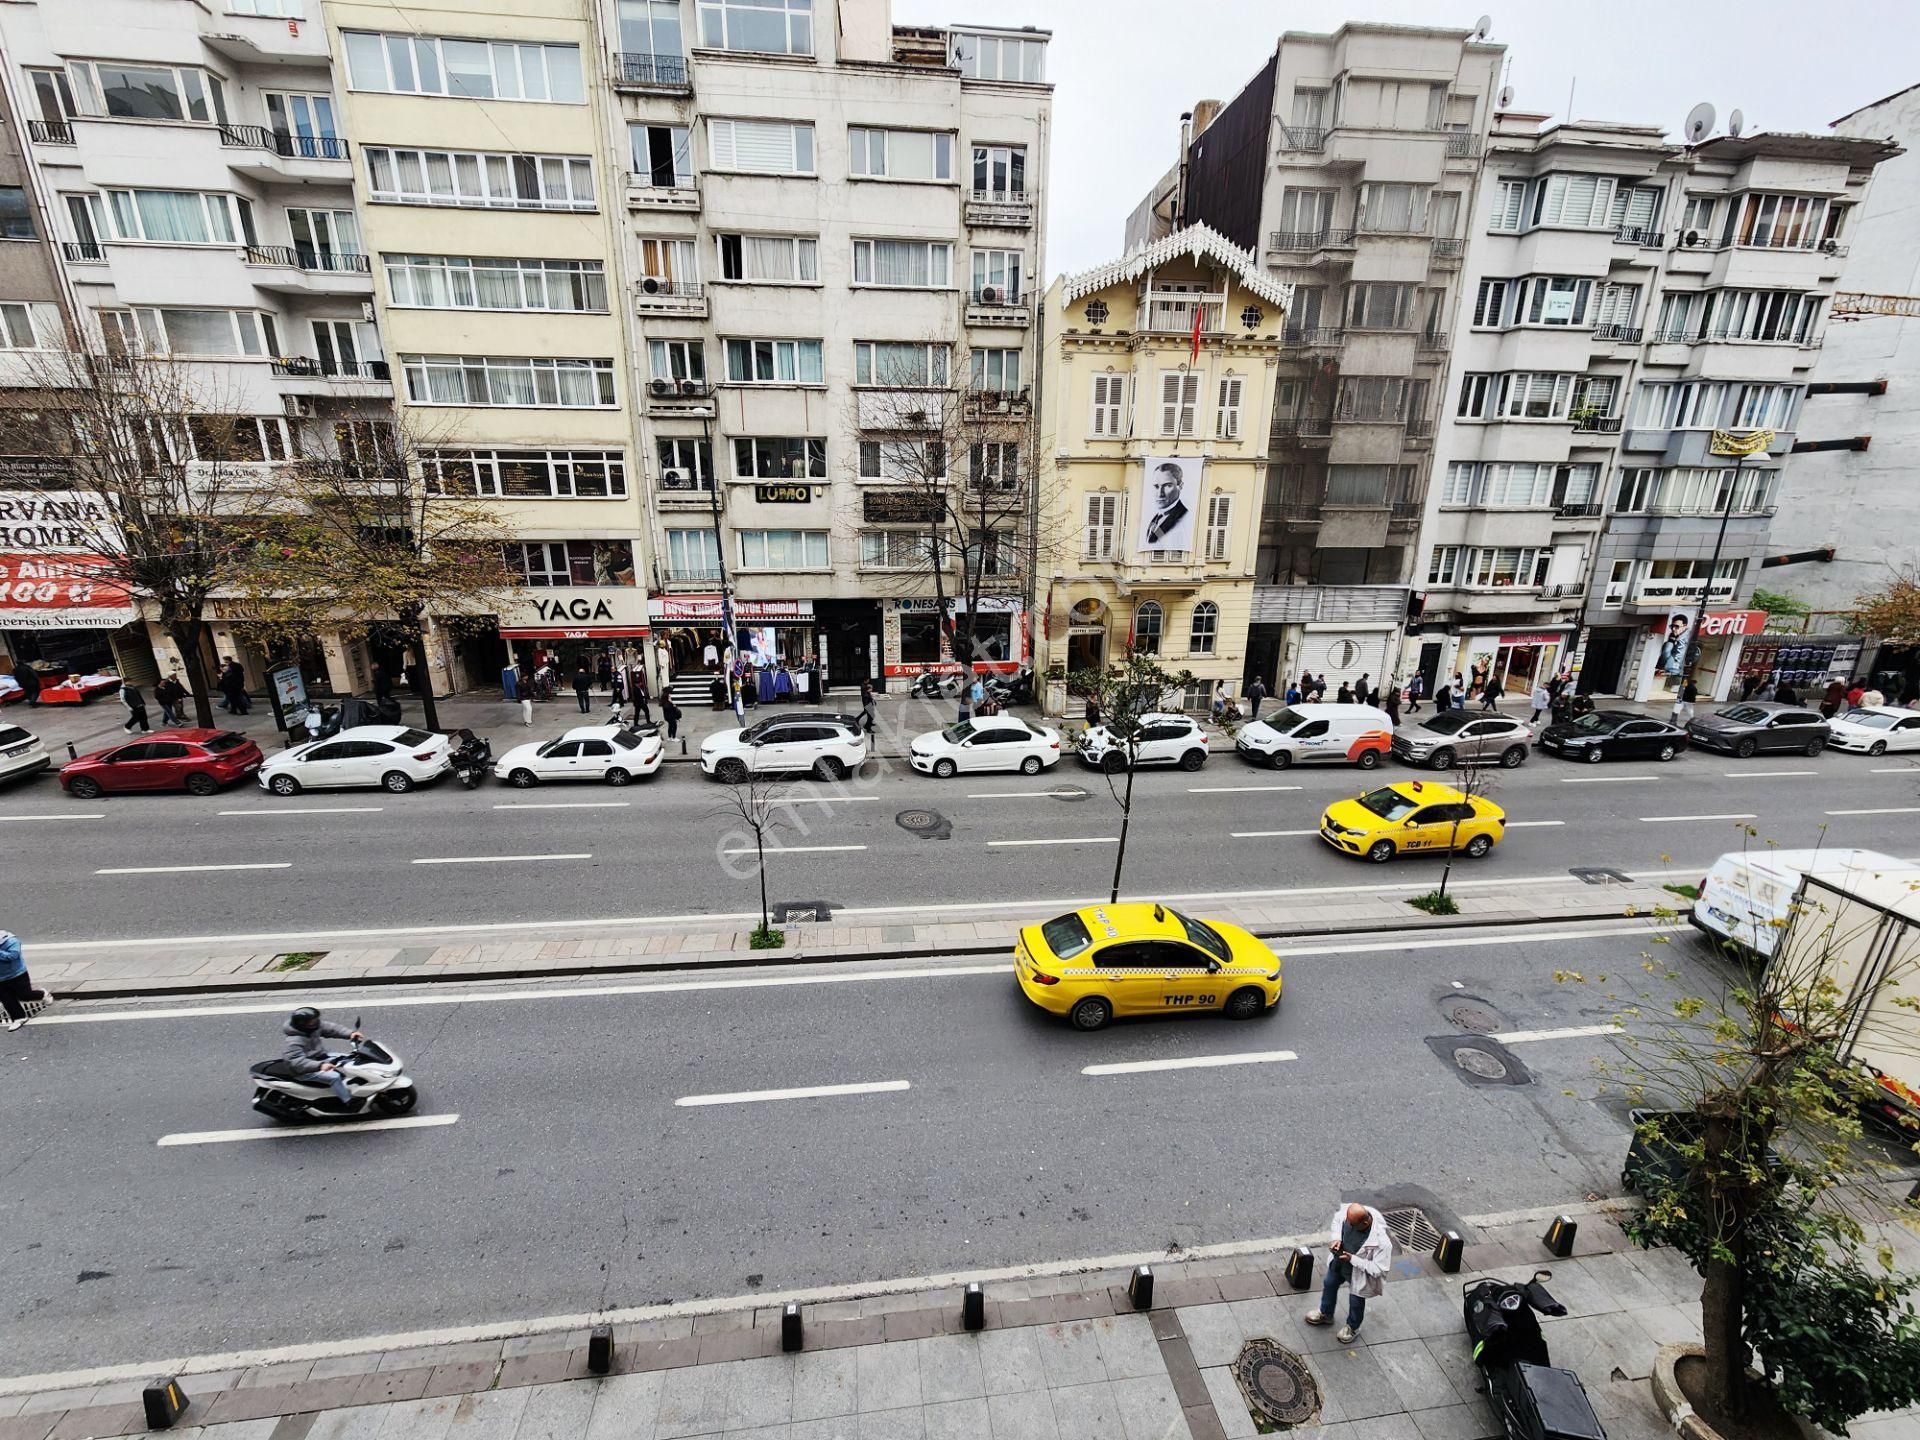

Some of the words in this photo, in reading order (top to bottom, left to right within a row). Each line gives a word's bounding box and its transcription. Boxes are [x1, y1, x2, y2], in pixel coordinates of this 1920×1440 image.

[531, 598, 614, 621] YAGA
[1164, 995, 1194, 1005] THP
[1198, 995, 1216, 1004] 90
